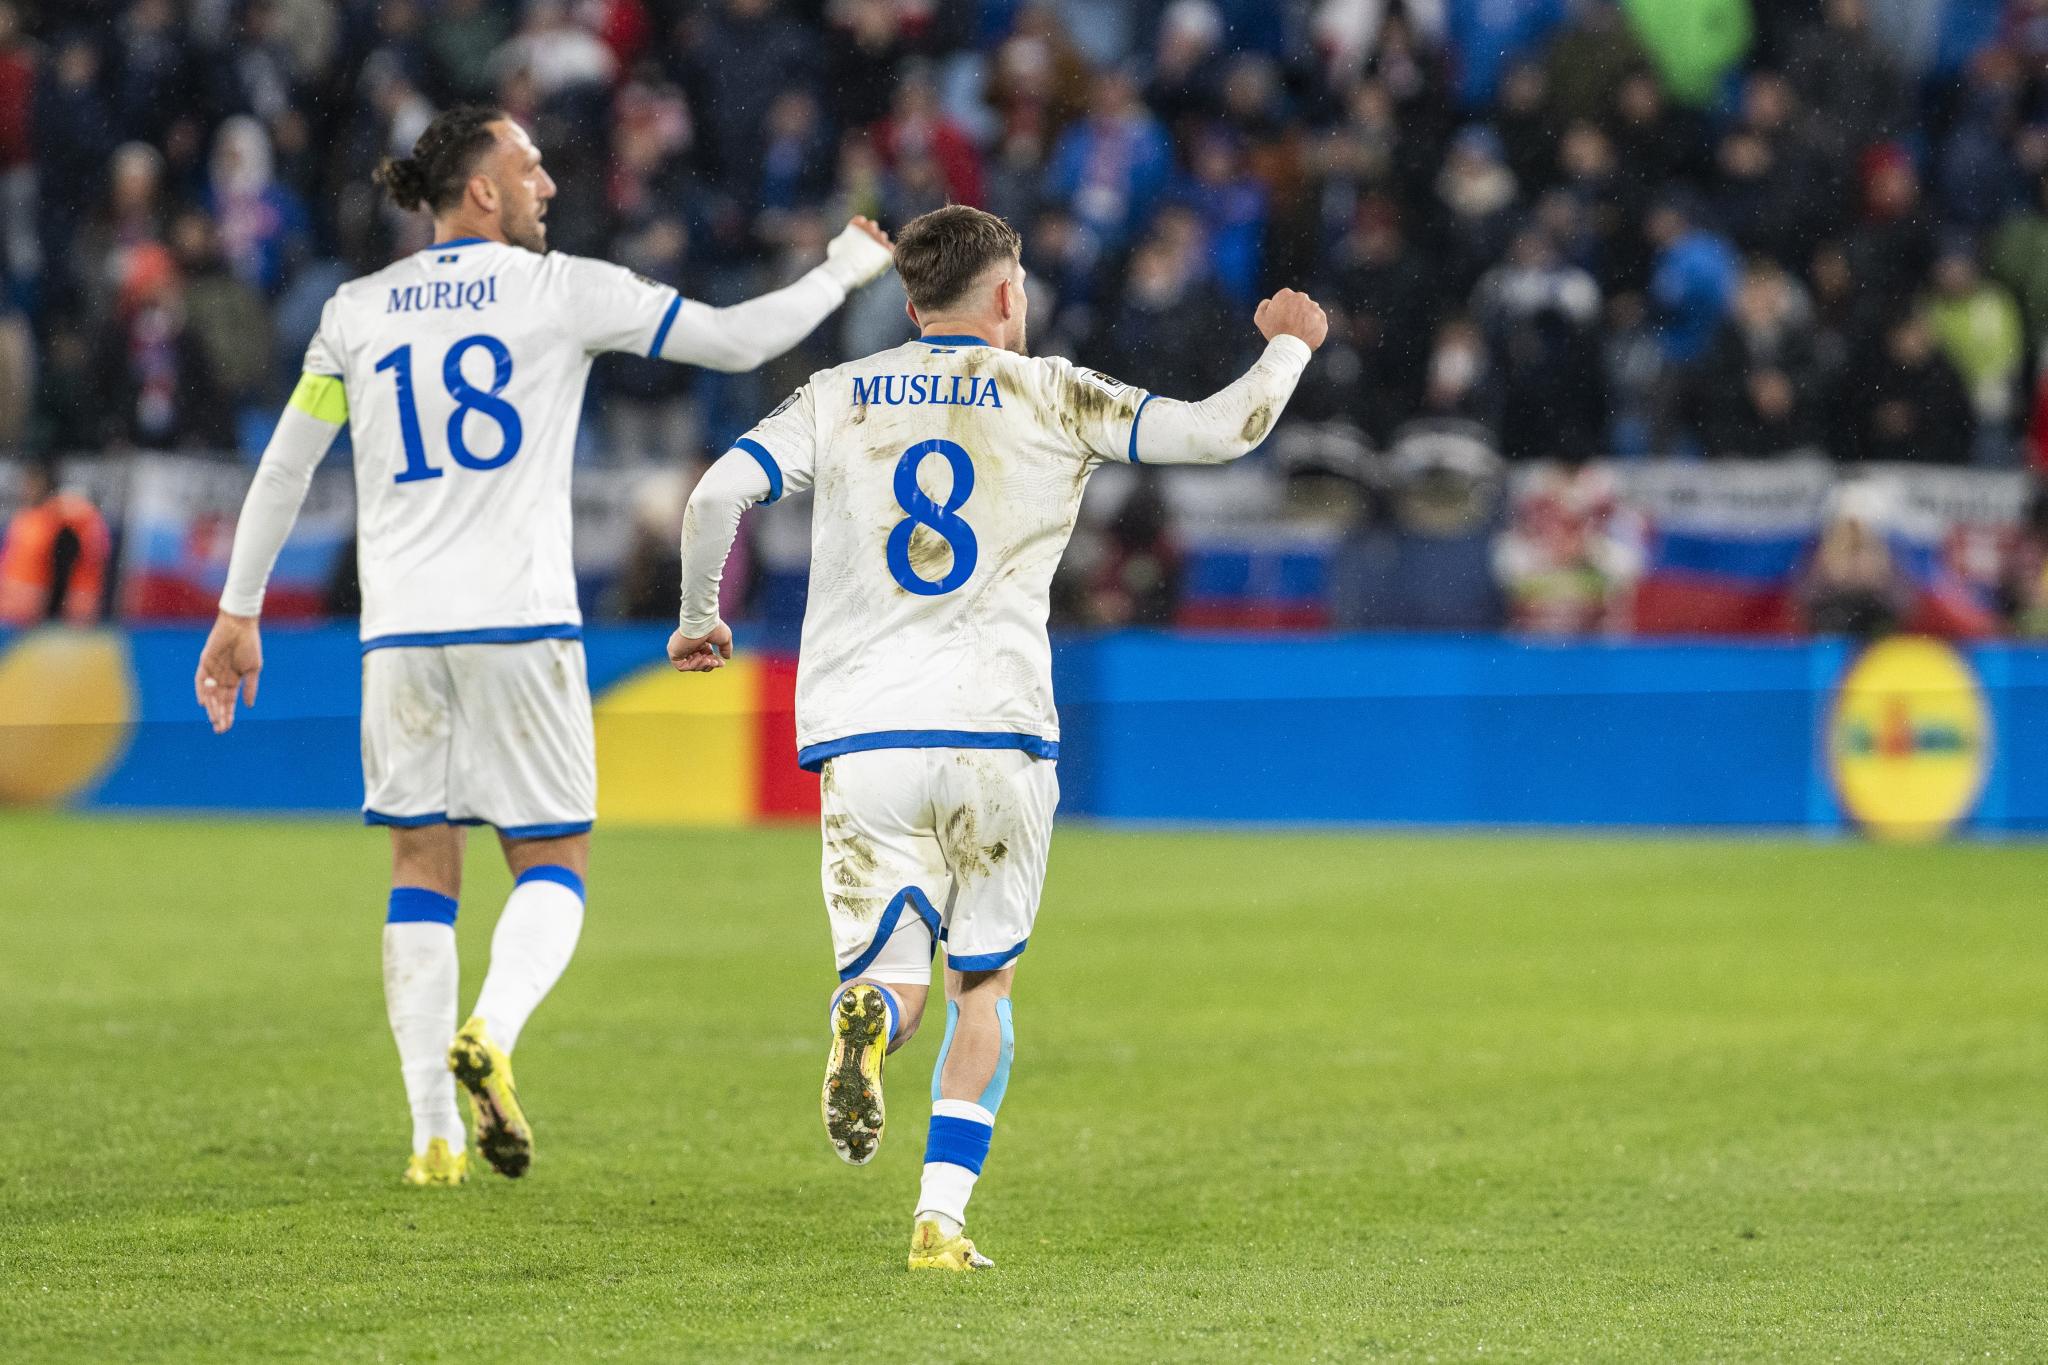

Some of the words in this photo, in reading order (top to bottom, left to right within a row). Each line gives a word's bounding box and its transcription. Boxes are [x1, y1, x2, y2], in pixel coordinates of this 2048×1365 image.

[386, 276, 499, 313] MURIQI
[375, 333, 523, 484] 18
[852, 374, 1003, 409] MUSLIJA
[886, 438, 979, 597] 8
